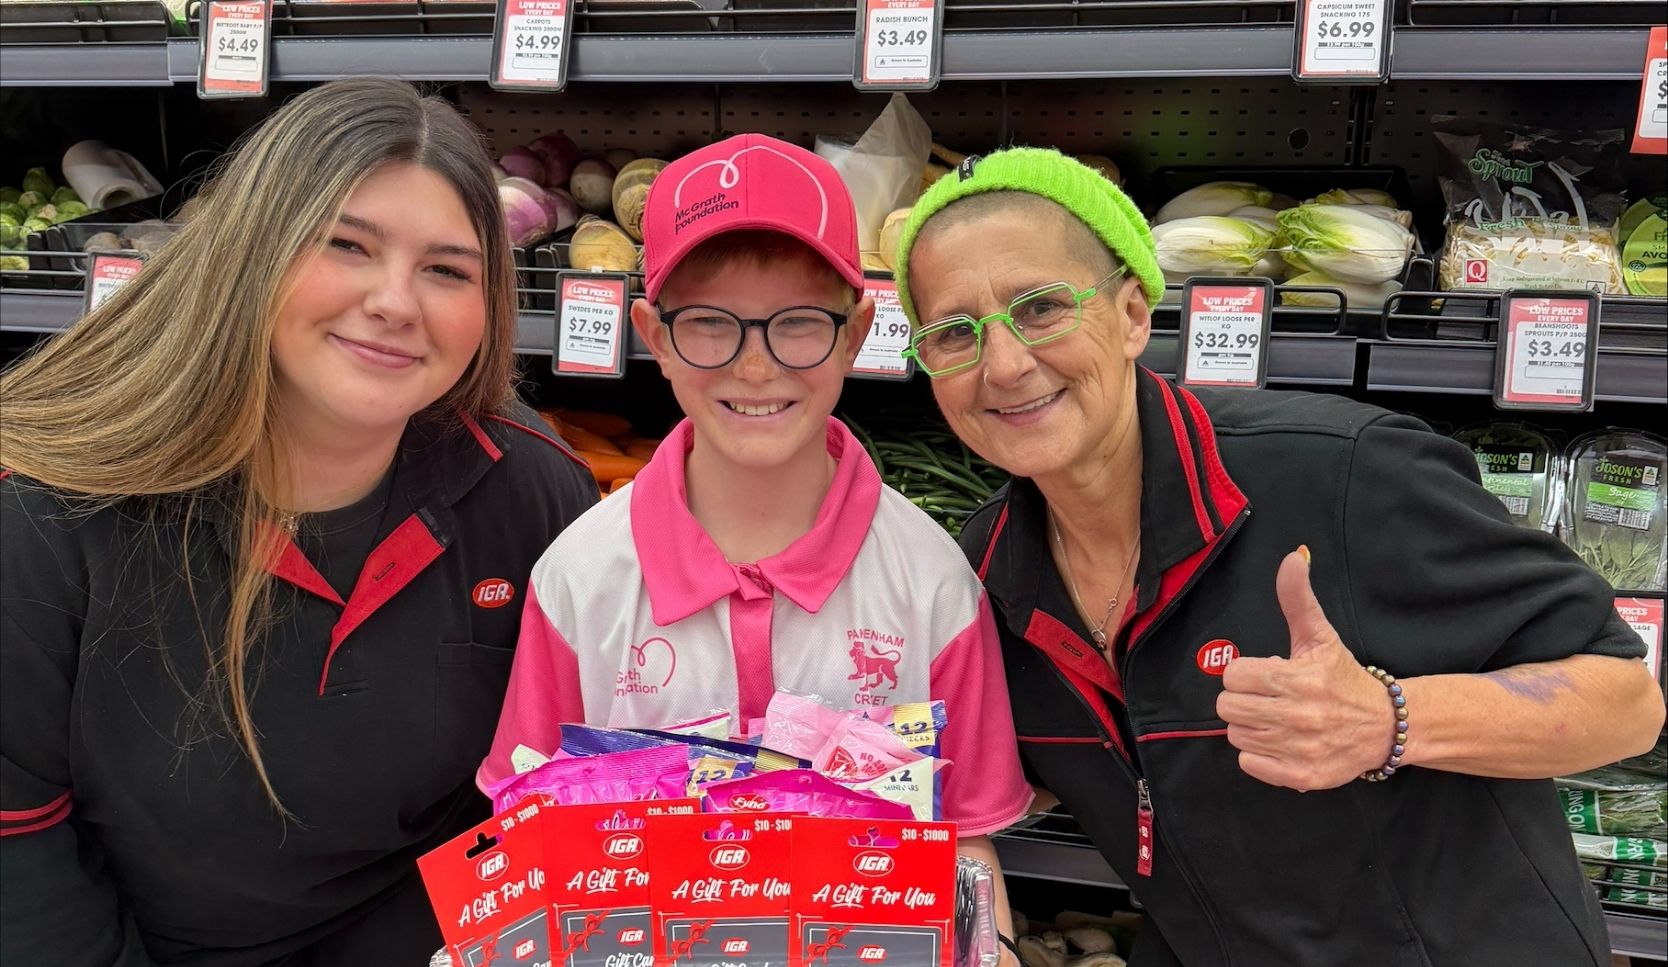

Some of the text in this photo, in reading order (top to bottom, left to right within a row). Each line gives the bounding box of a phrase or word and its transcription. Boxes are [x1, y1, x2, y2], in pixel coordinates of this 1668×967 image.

[1318, 20, 1375, 38] $6.99
[218, 37, 258, 52] $4.49
[515, 33, 560, 49] $4.99
[877, 29, 927, 47] $3.49
[675, 192, 726, 223] McGrath
[675, 200, 739, 235] Foundation
[1642, 250, 1667, 259] AVO
[1203, 297, 1254, 306] LOW PRICES
[1529, 305, 1583, 316] LOW PRICES
[569, 316, 612, 335] $7.99
[874, 322, 909, 338] 1.99
[1194, 331, 1259, 348] $32.99
[1528, 339, 1585, 357] $3.49
[1596, 462, 1643, 479] JOSON'S
[1603, 474, 1632, 485] FRESH
[1609, 486, 1637, 501] Sage
[478, 583, 509, 602] IGA
[1203, 645, 1233, 668] IGA
[854, 693, 888, 706] CRET
[501, 816, 515, 831] $10
[517, 804, 540, 822] $1000
[755, 819, 769, 832] $10
[776, 819, 792, 831] $10
[902, 828, 917, 840] $10
[923, 829, 949, 841] $1000
[608, 838, 639, 854] IGA
[715, 849, 745, 865] IGA
[858, 856, 889, 871] IGA
[481, 854, 506, 879] IGA
[567, 871, 584, 890] A
[586, 867, 618, 893] Gift
[458, 867, 545, 928] A Gift For Yo
[671, 880, 690, 899] A
[691, 876, 728, 903] Gift
[729, 878, 760, 898] For
[812, 882, 936, 910] A Gift For You
[621, 930, 644, 943] IGA
[515, 939, 535, 960] IGA
[724, 940, 749, 952] IGA
[860, 947, 886, 960] IGA
[605, 951, 634, 967] Gift
